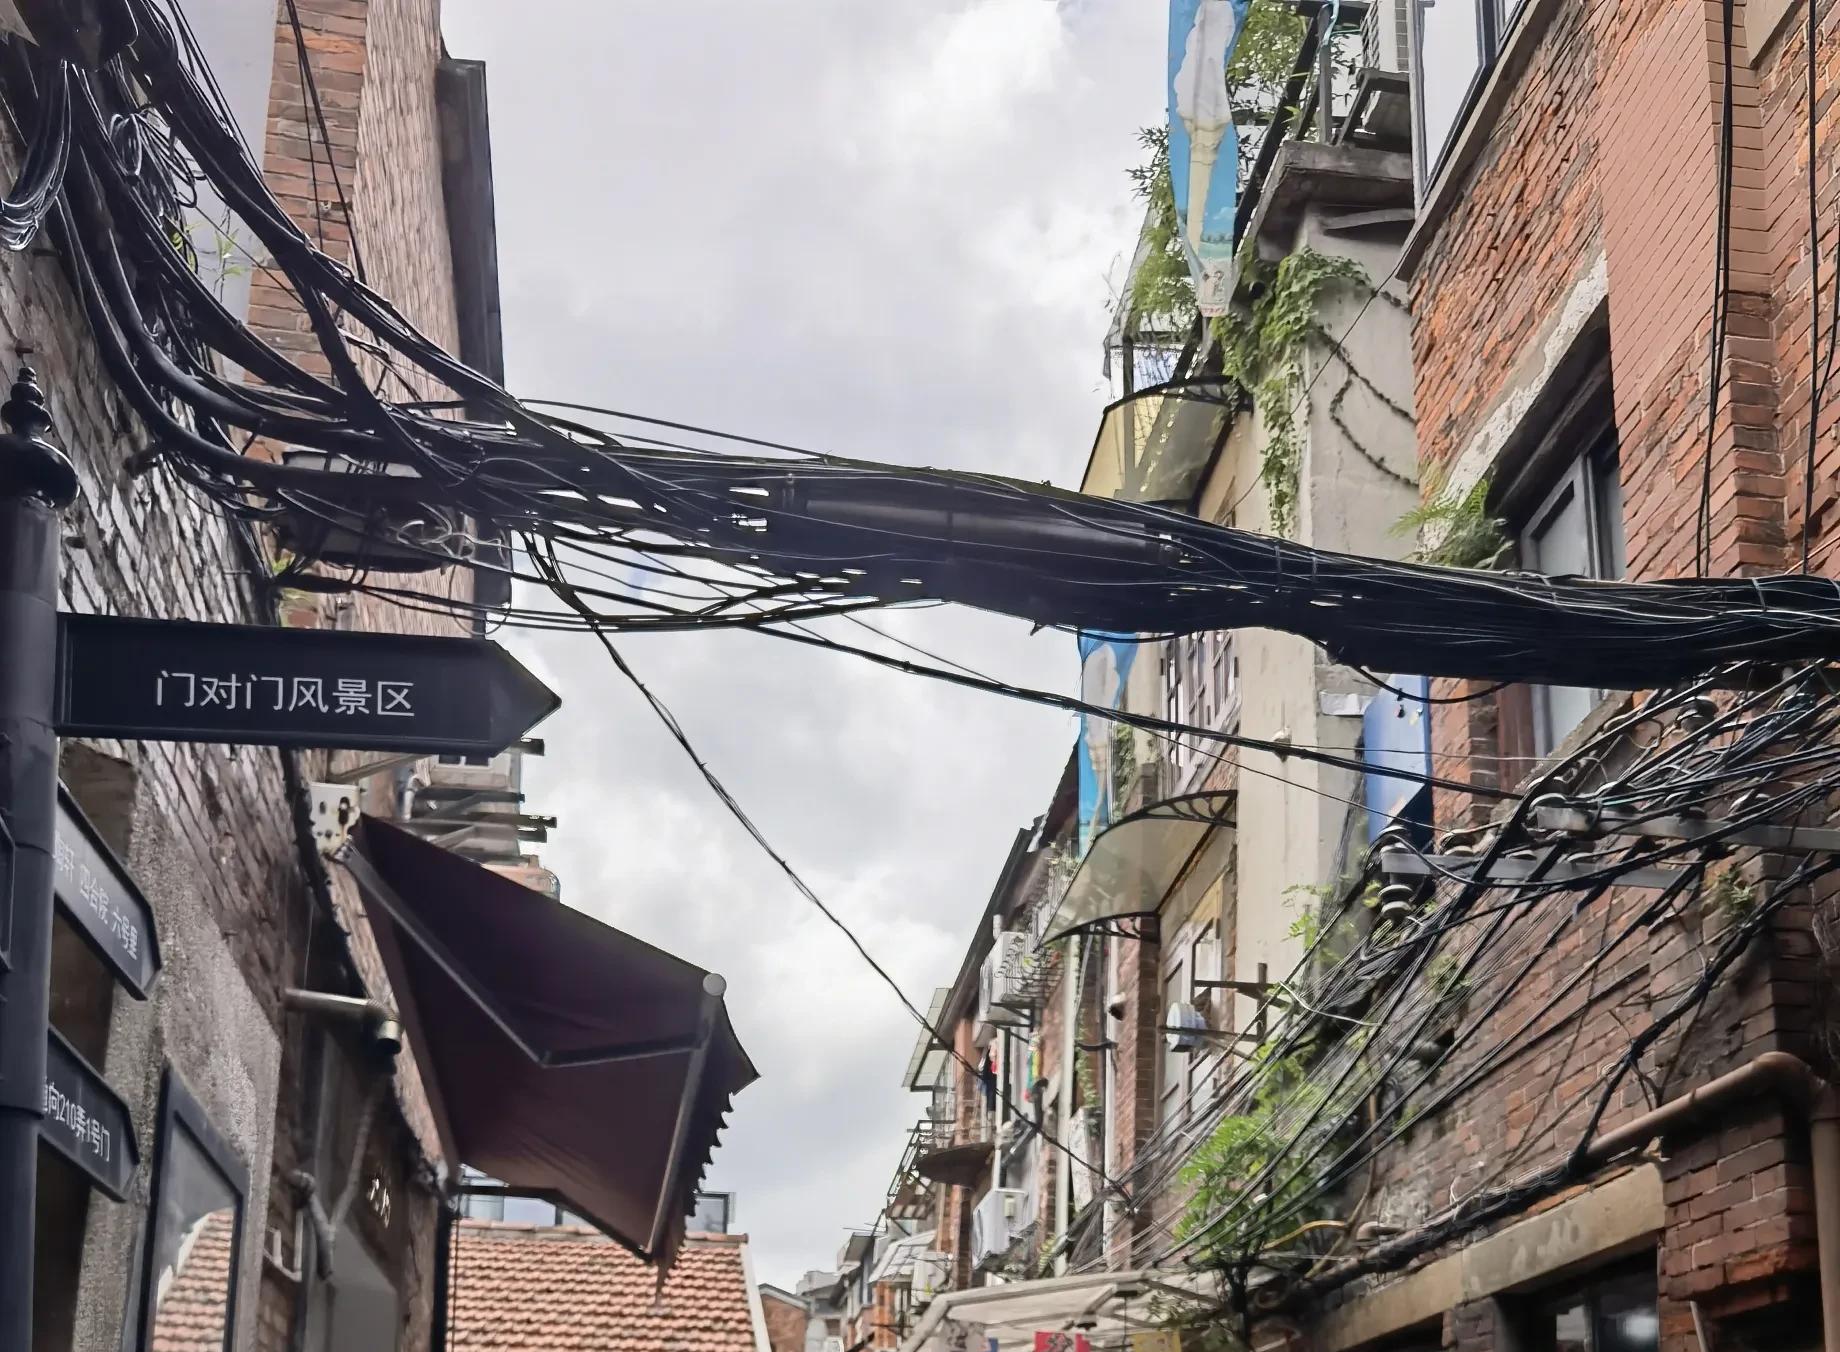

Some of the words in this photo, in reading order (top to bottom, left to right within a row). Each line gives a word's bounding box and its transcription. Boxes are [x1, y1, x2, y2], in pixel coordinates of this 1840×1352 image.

[156, 669, 416, 718] 门对门风景区
